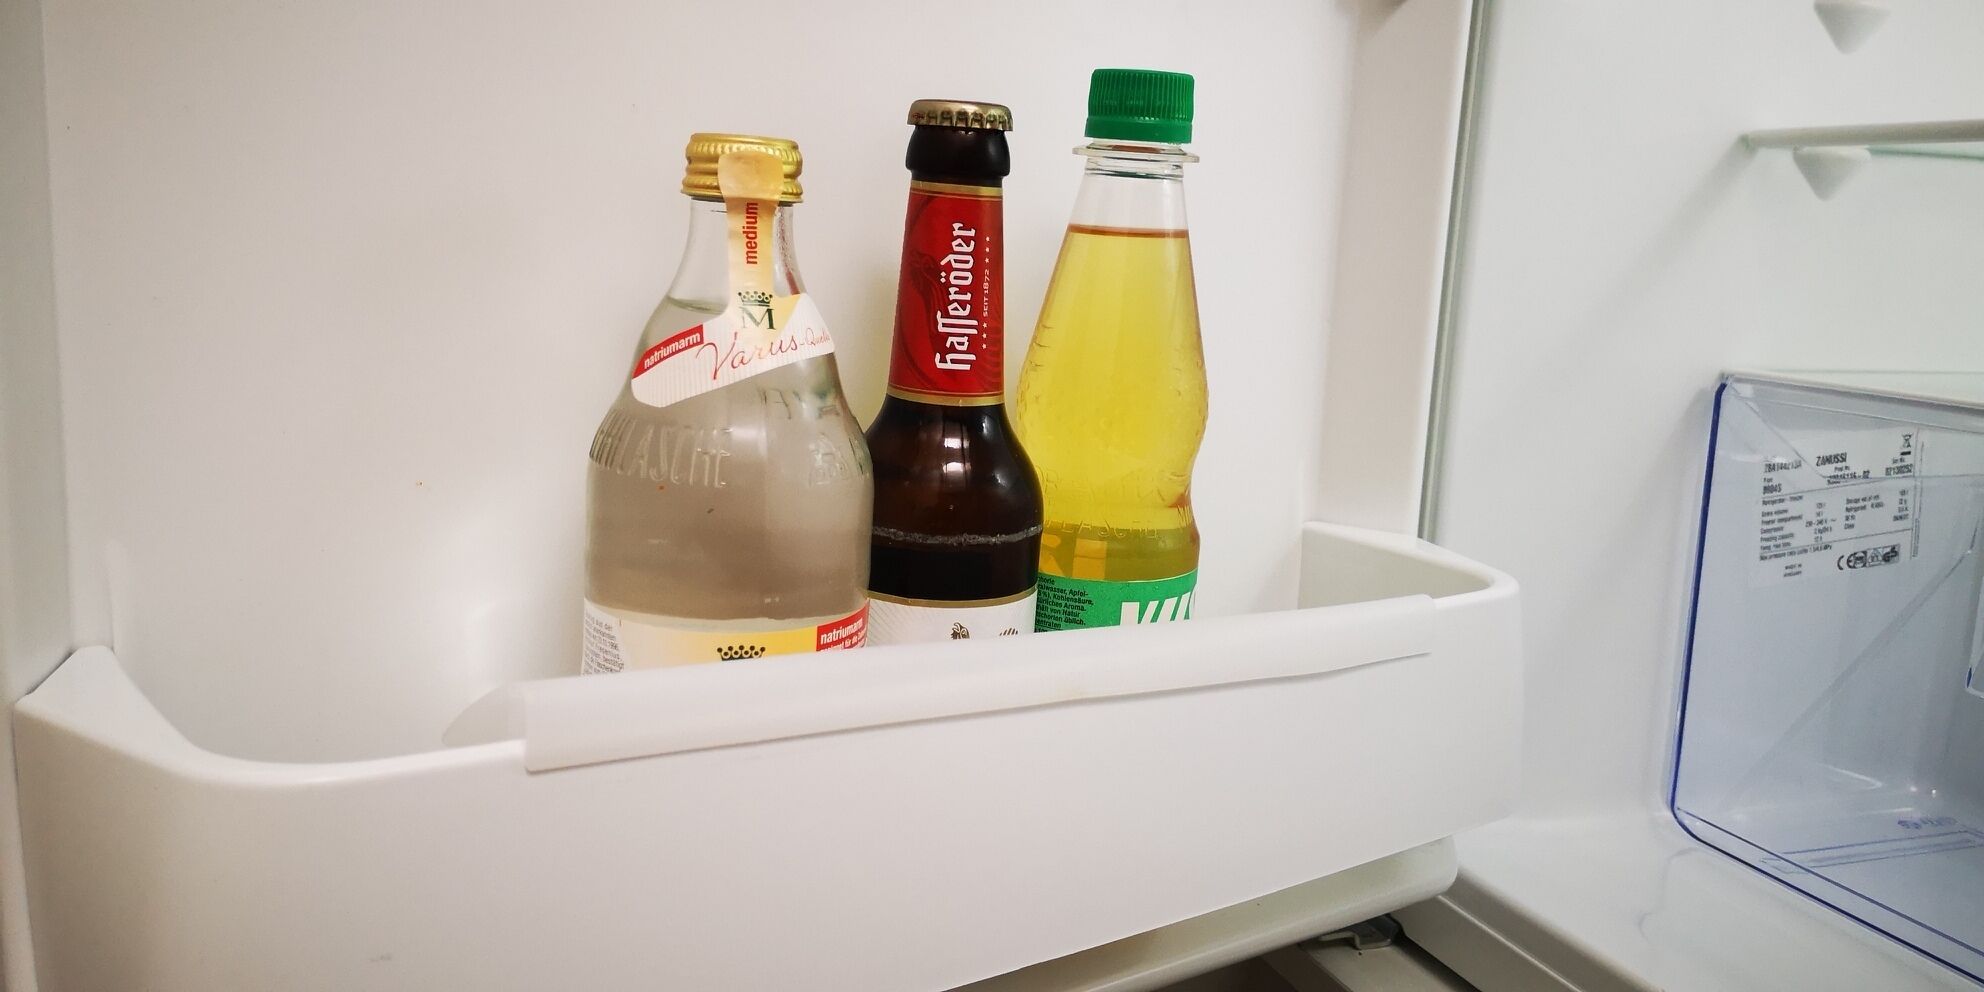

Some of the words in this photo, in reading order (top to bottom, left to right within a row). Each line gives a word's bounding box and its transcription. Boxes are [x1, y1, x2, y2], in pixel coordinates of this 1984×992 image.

[742, 202, 758, 264] medium
[740, 308, 776, 330] M
[644, 331, 701, 369] natriumarm
[1816, 452, 1847, 467] ZANUSSI
[1053, 593, 1095, 607] Kohlensäure,
[1069, 588, 1089, 598] Apfel-
[1050, 607, 1061, 615] von
[1064, 602, 1087, 612] Aroma.
[1063, 617, 1086, 626] üblich.
